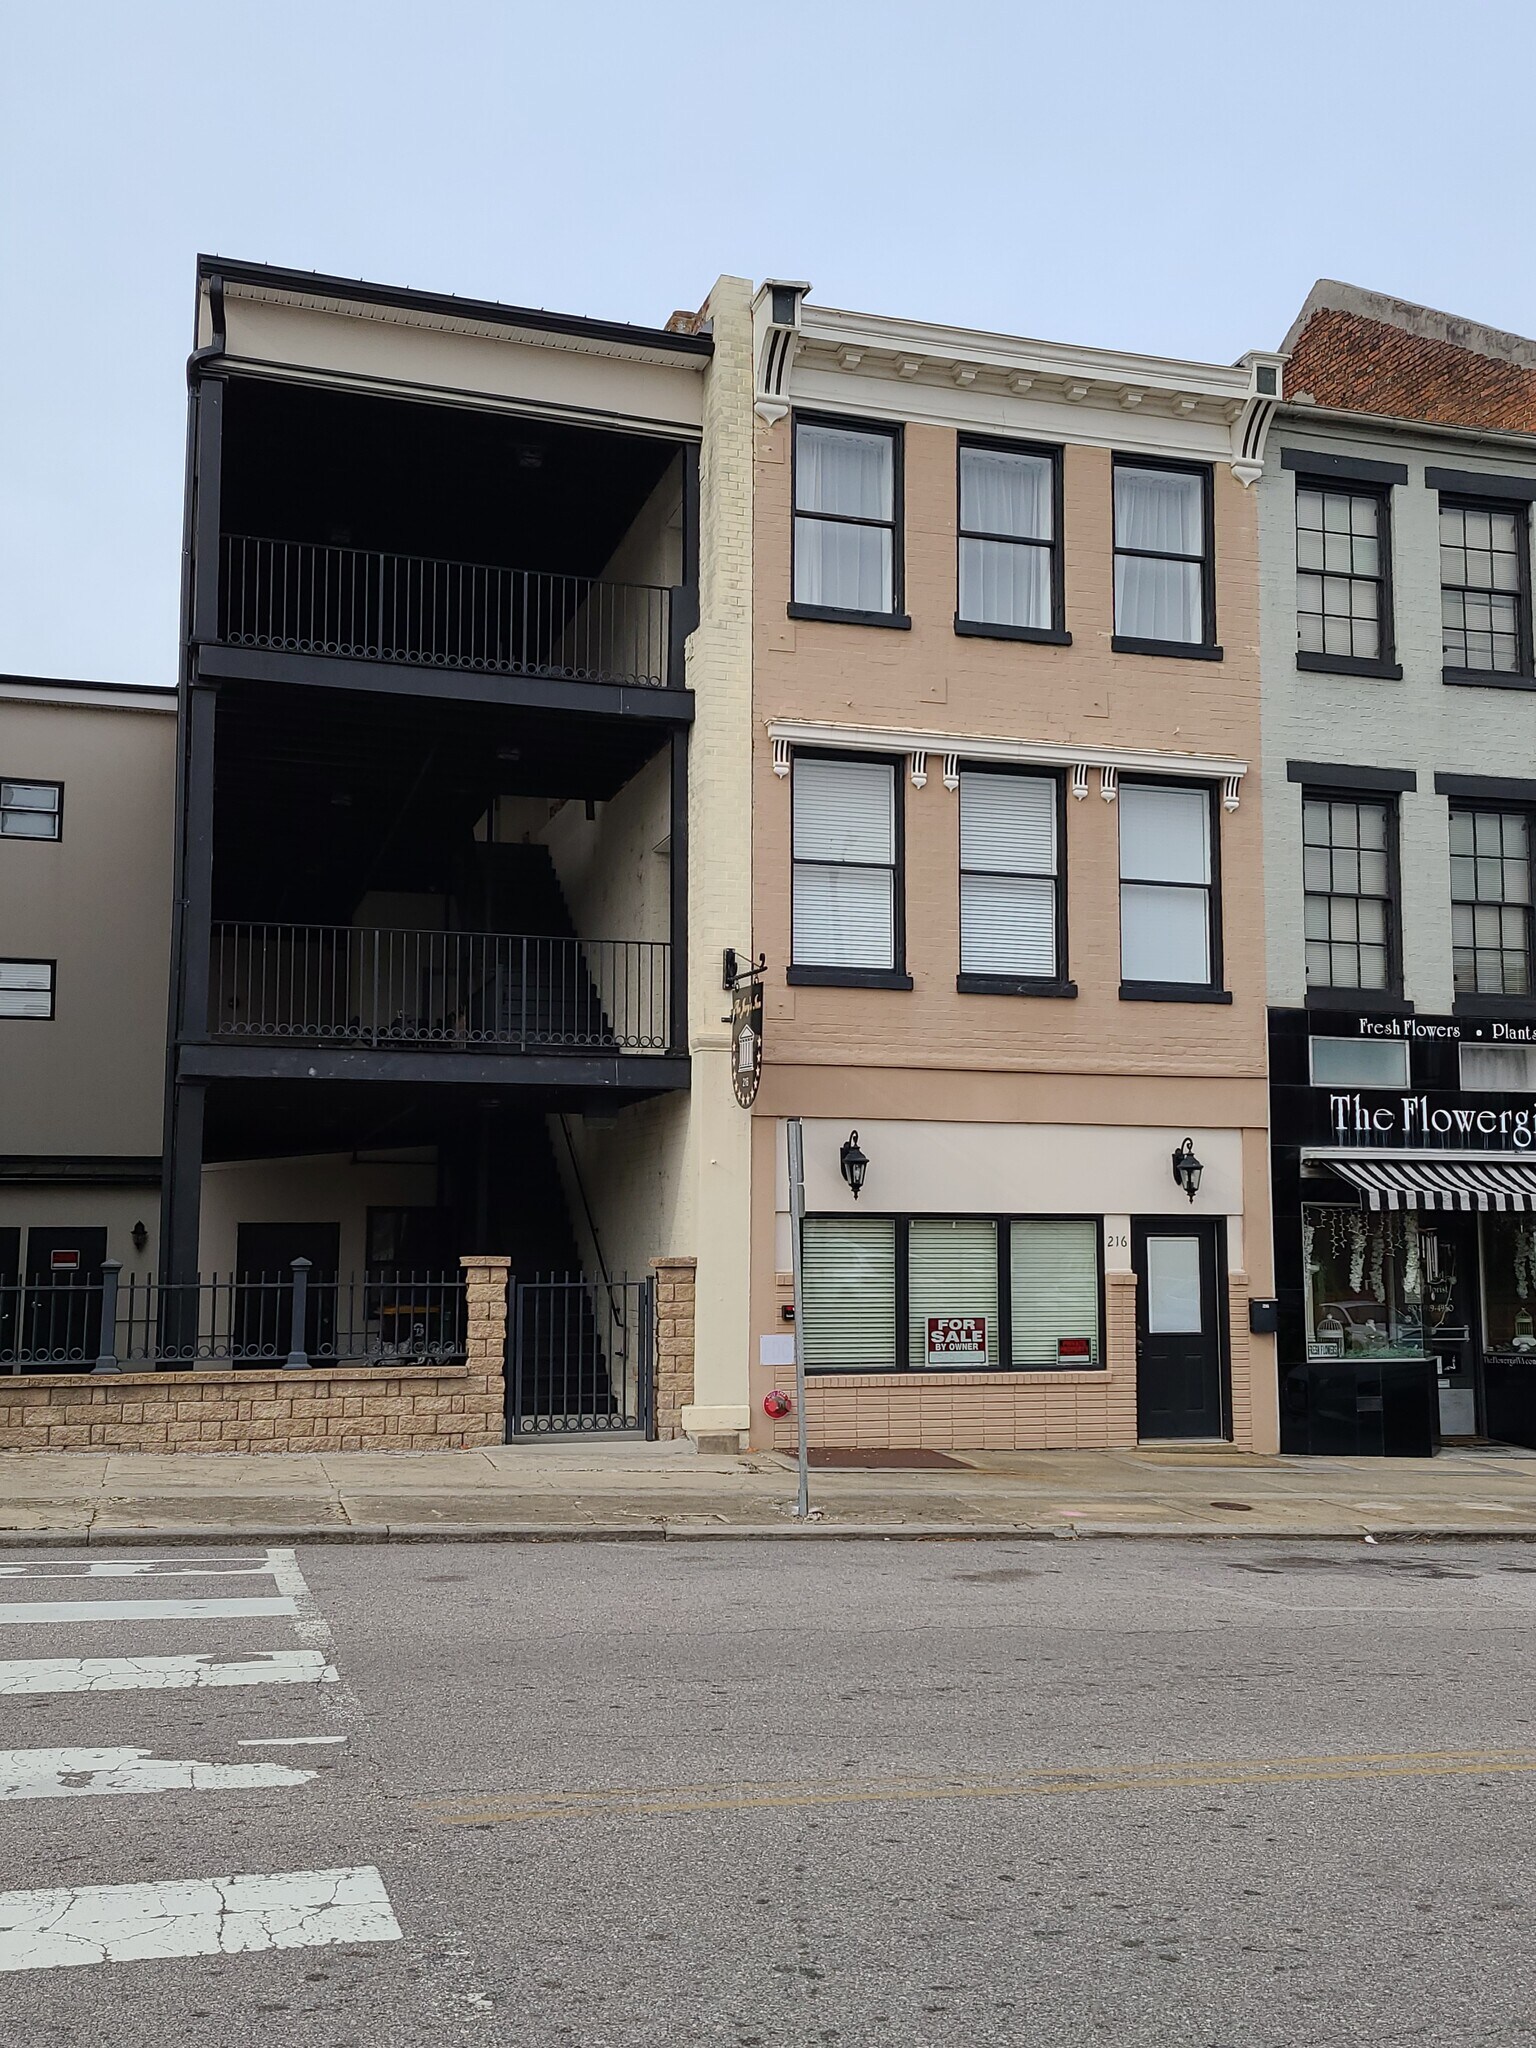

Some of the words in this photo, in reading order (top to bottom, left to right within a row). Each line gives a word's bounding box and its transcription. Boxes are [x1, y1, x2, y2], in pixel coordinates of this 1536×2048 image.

[1359, 1017, 1401, 1036] Fresh
[1403, 1019, 1461, 1038] Flowers
[1491, 1023, 1536, 1041] Plants
[1330, 1093, 1396, 1131] The
[1107, 1235, 1128, 1248] 216
[937, 1319, 976, 1331] FOR
[930, 1330, 983, 1343] SALE
[935, 1343, 947, 1351] BY
[948, 1342, 979, 1351] OWNER
